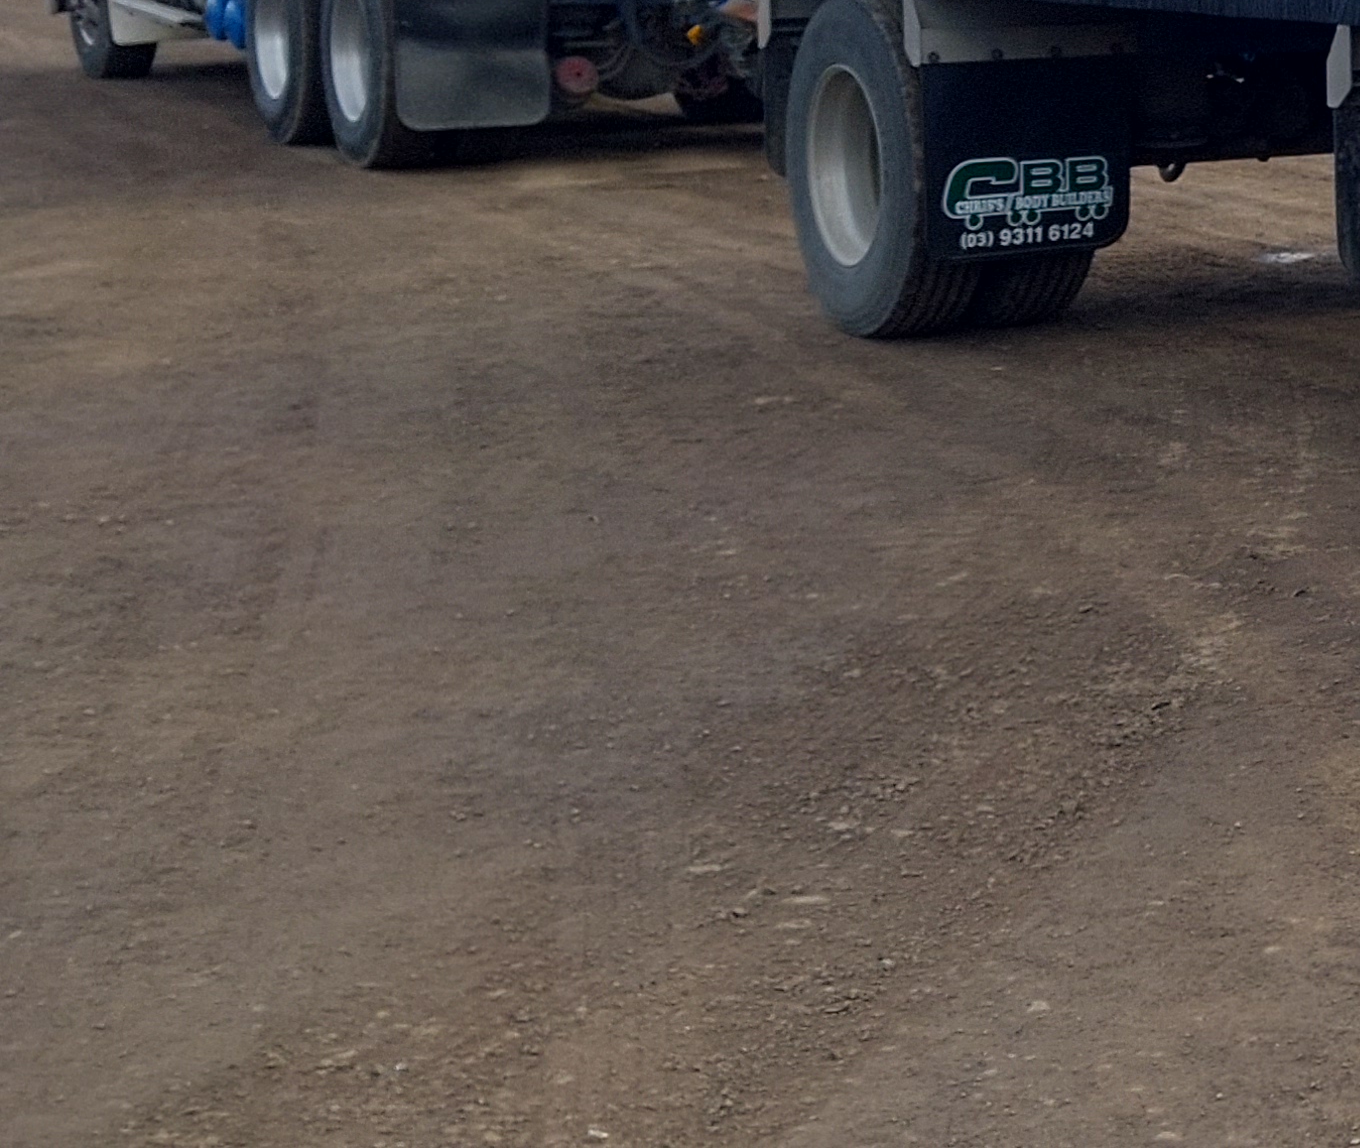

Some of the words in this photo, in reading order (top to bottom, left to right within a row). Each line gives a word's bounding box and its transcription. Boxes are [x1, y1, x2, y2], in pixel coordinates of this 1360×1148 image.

[943, 156, 1109, 219] CBB
[1015, 194, 1050, 210] BODY
[1051, 188, 1113, 207] BUILDERS
[959, 230, 995, 251] (03)
[999, 225, 1043, 247] 9311
[1048, 221, 1095, 242] 6124
